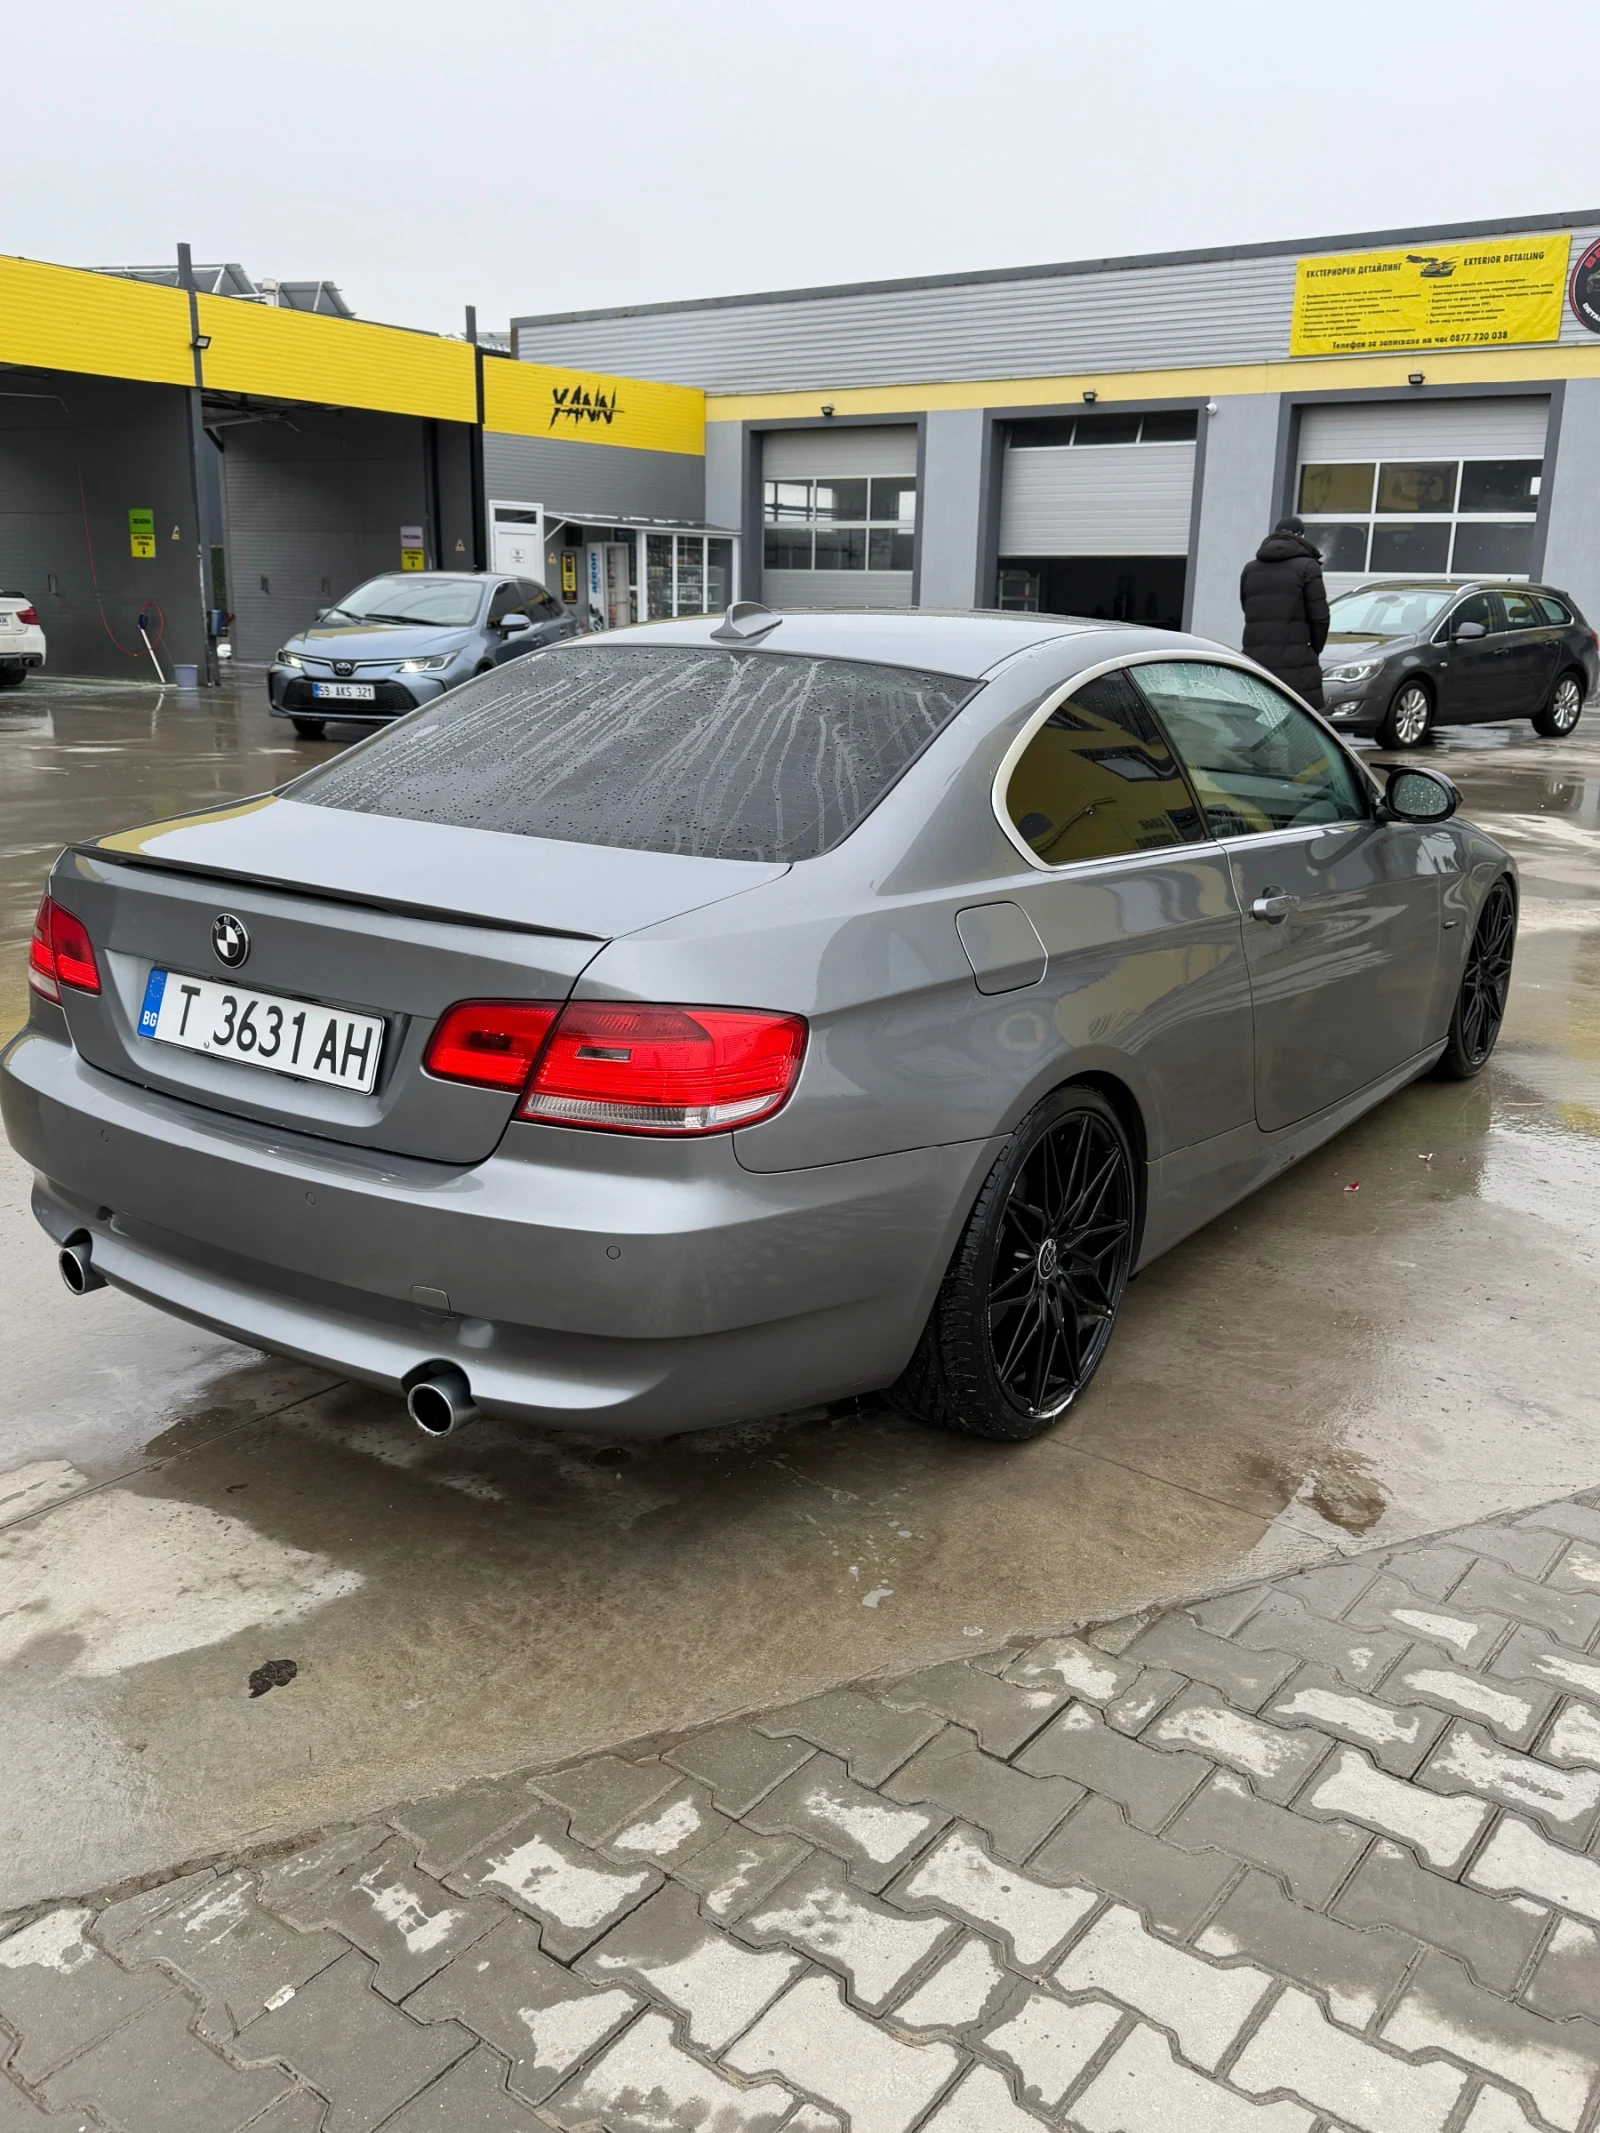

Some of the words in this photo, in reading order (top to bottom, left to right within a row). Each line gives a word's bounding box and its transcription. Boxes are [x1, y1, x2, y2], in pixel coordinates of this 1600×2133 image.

[1463, 255, 1501, 266] EXTERIOR
[1503, 251, 1545, 263] DETAILING
[1306, 267, 1356, 278] ЕКСТЕРИОРЕН
[1358, 263, 1402, 275] ДЕТАЙЛИНГ
[1450, 333, 1471, 342] 0877
[1474, 332, 1489, 341] 720
[1491, 331, 1508, 340] 038
[590, 552, 598, 594] areon
[336, 686, 352, 697] AKS
[356, 687, 372, 698] 321
[214, 916, 243, 936] BMW
[142, 1010, 158, 1027] BG
[179, 984, 201, 1036] T
[212, 995, 306, 1065] 3631
[313, 1018, 373, 1081] AH
